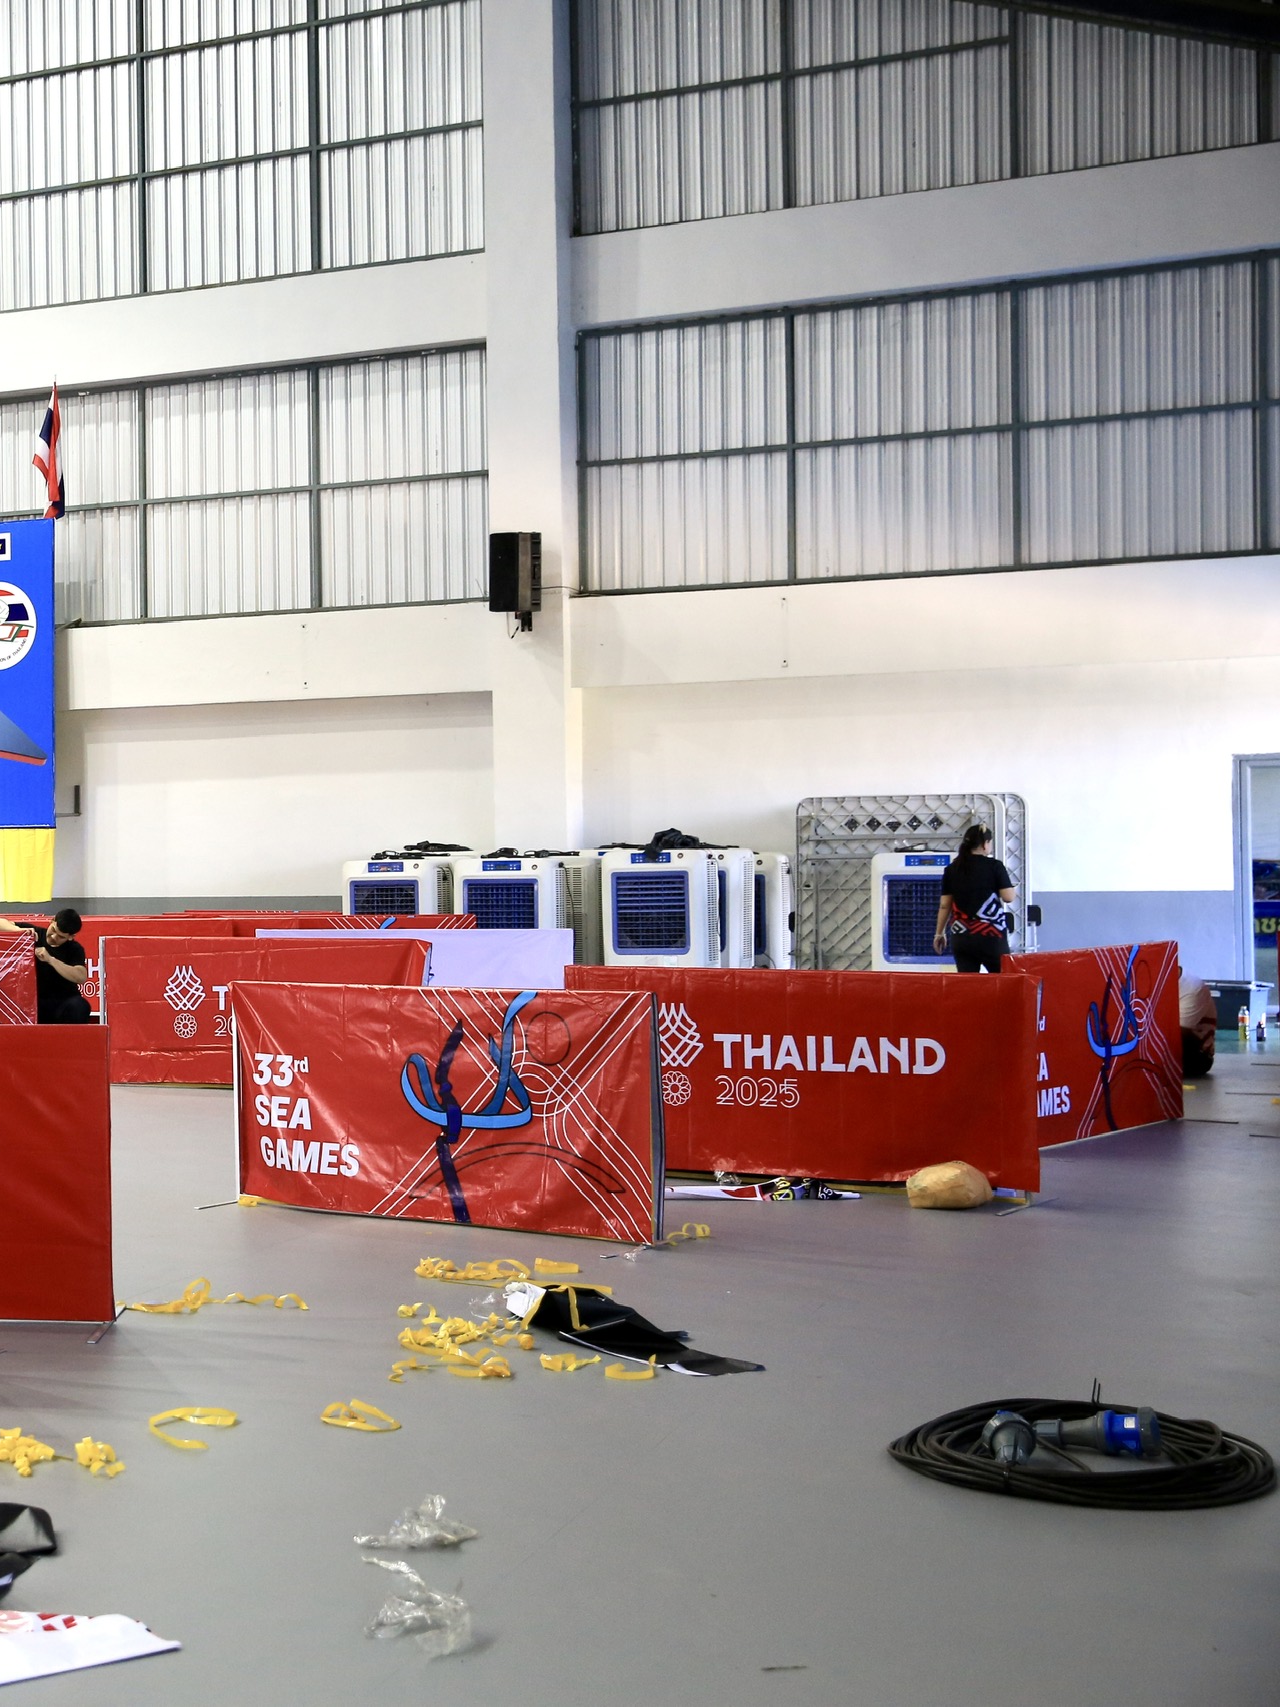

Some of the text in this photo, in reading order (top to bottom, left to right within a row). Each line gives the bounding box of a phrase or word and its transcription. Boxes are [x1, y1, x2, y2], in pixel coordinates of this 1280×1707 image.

[252, 1052, 309, 1087] 33rd
[713, 1033, 946, 1075] THAILAND
[714, 1075, 800, 1109] 2025
[254, 1094, 312, 1131] SEA
[260, 1135, 360, 1178] GAMES
